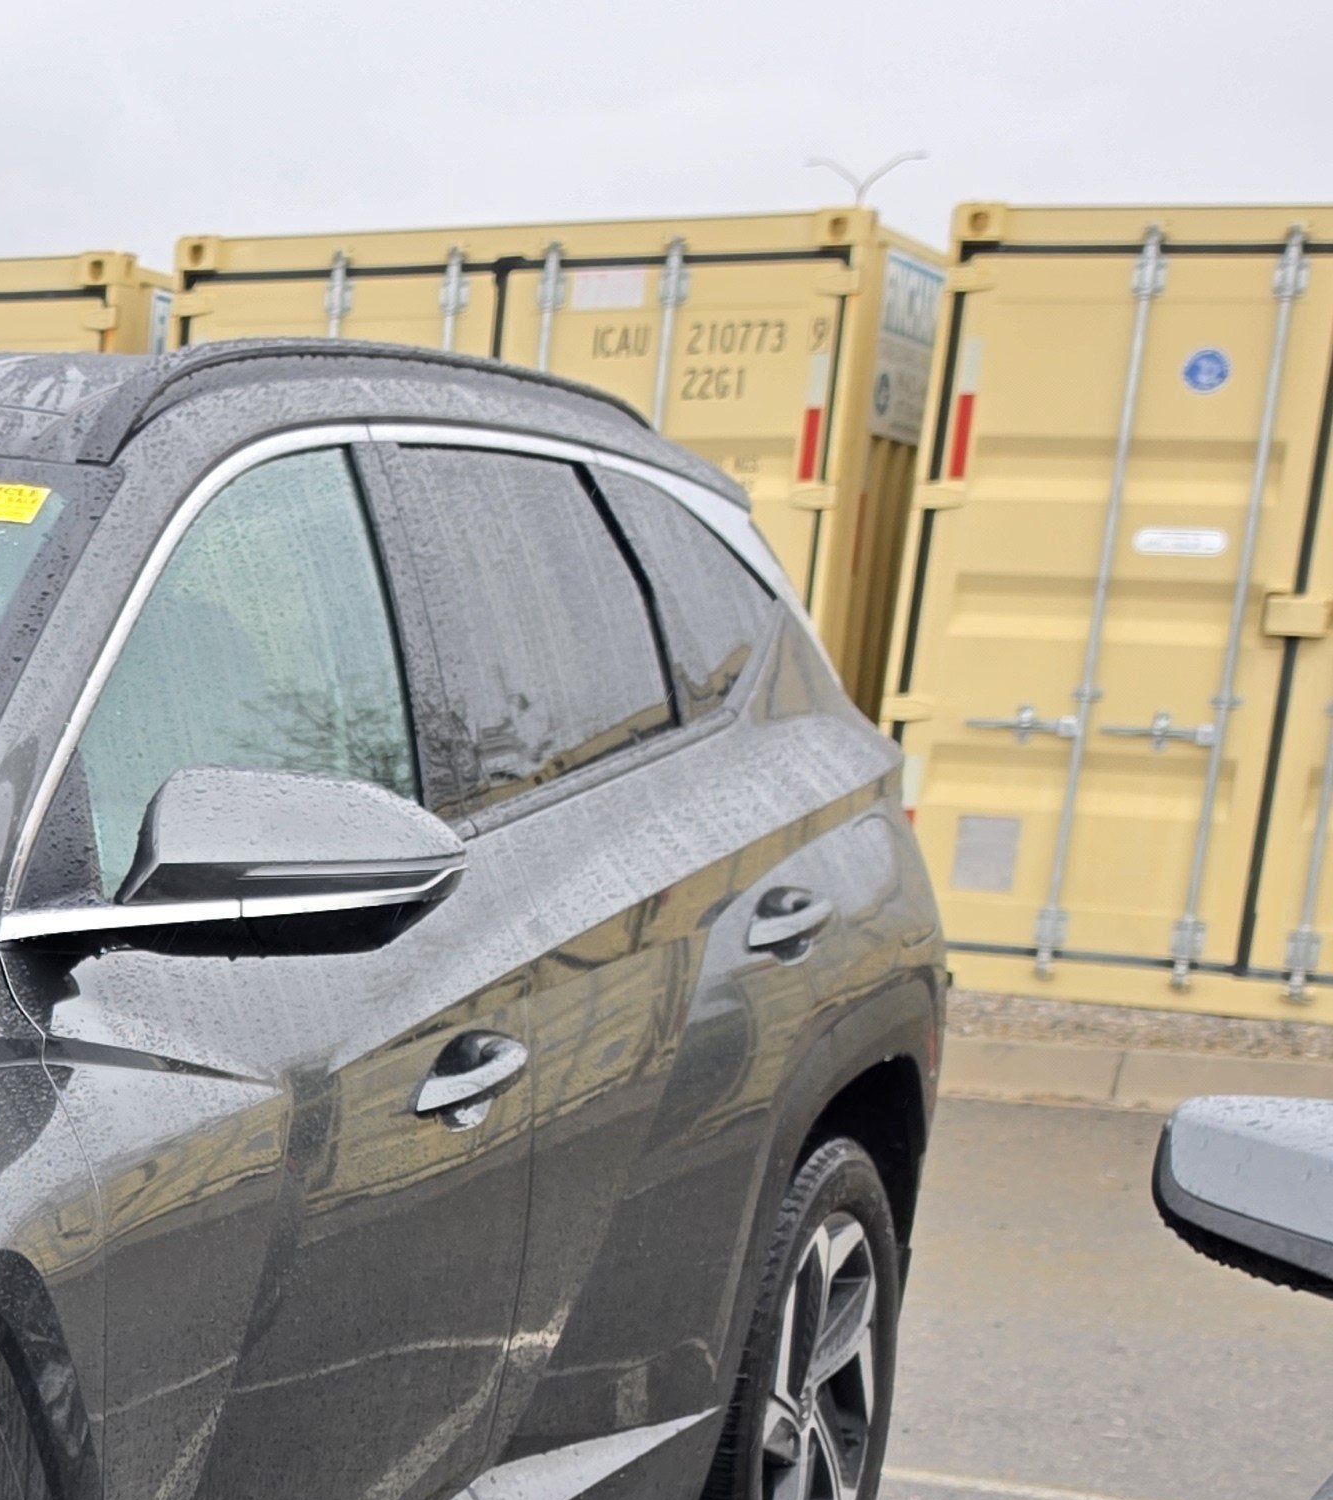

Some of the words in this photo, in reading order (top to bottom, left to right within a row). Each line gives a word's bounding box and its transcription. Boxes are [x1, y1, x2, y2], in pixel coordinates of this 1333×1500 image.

[592, 323, 652, 358] ICAU
[685, 319, 787, 354] 210773
[808, 317, 829, 350] 9
